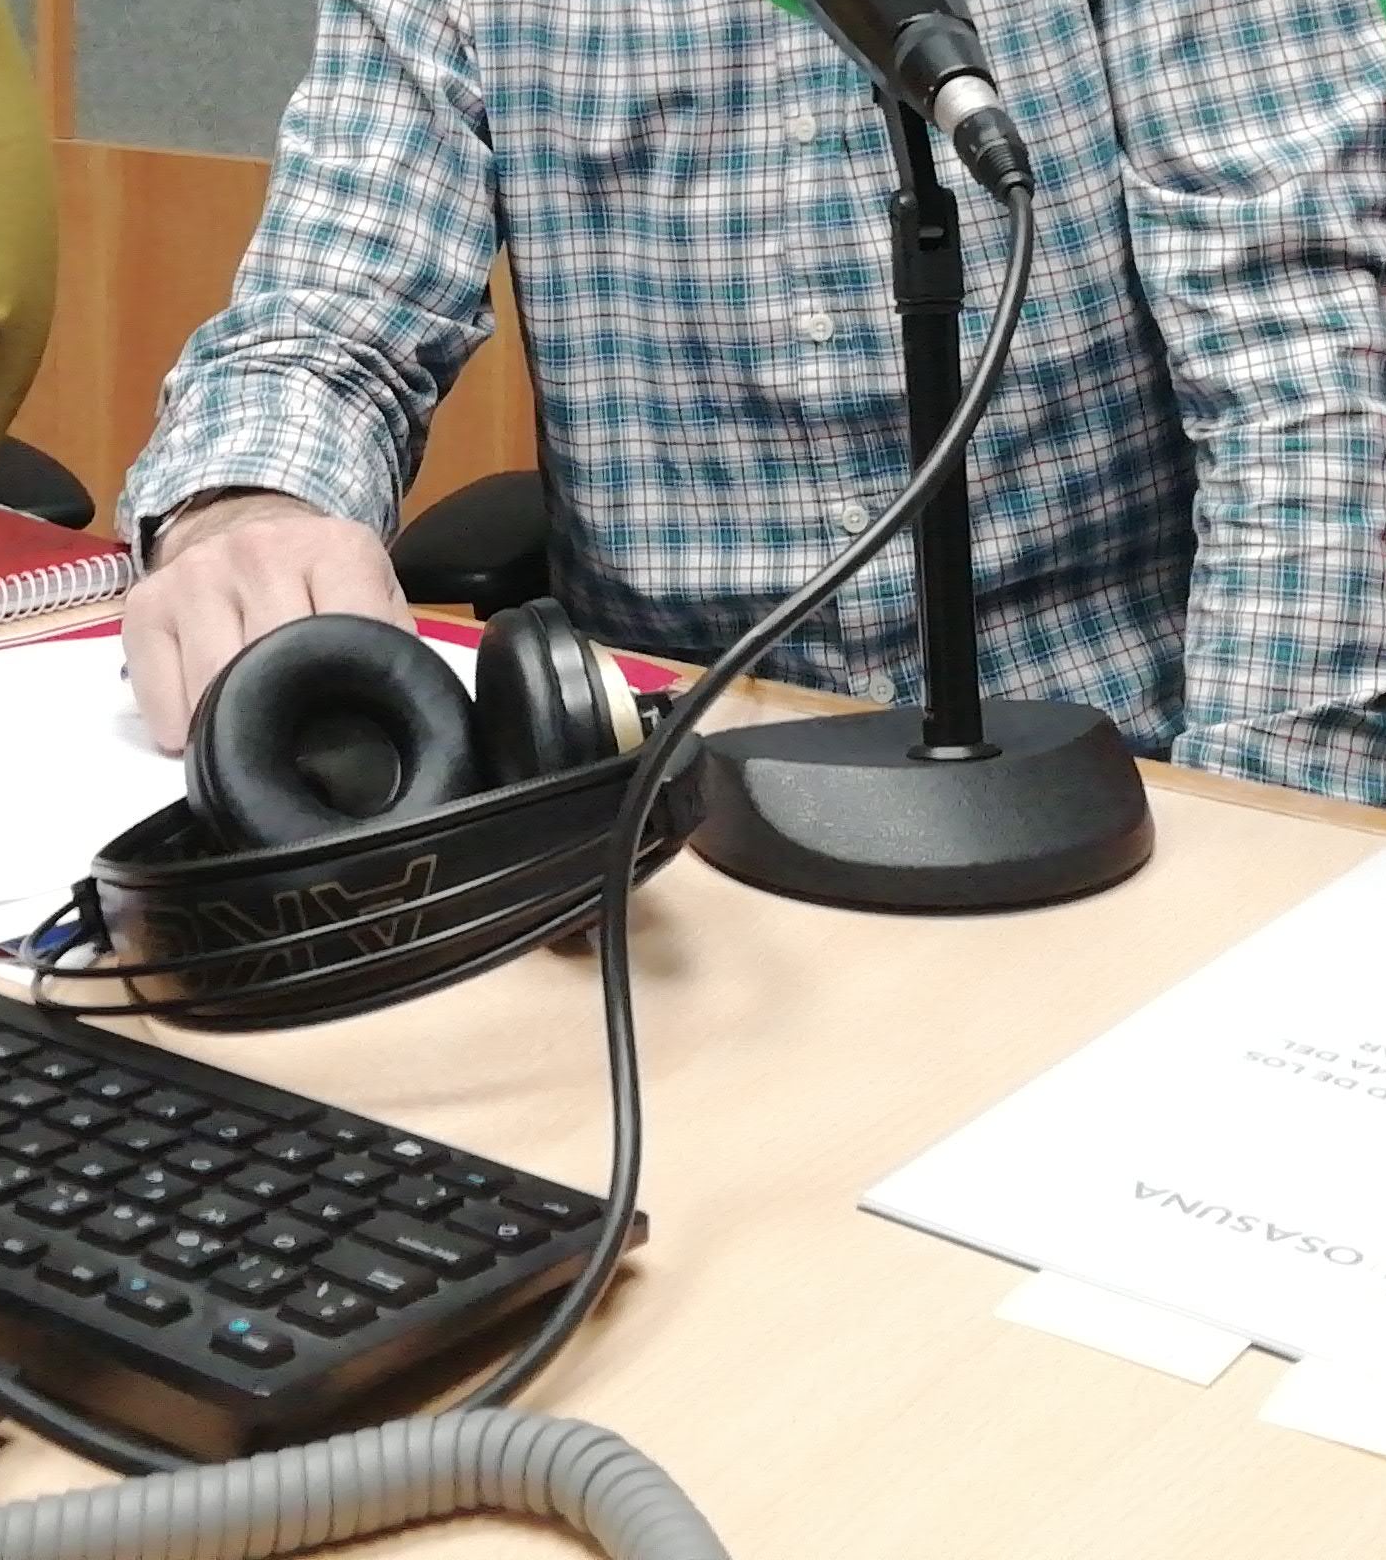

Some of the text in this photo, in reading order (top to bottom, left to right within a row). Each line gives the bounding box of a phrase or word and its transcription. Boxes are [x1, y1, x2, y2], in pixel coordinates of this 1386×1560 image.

[1282, 1039, 1340, 1062] DEL
[1243, 1051, 1305, 1075] LOS
[1311, 1070, 1359, 1090] DE
[1131, 1180, 1365, 1267] OSASUNA
